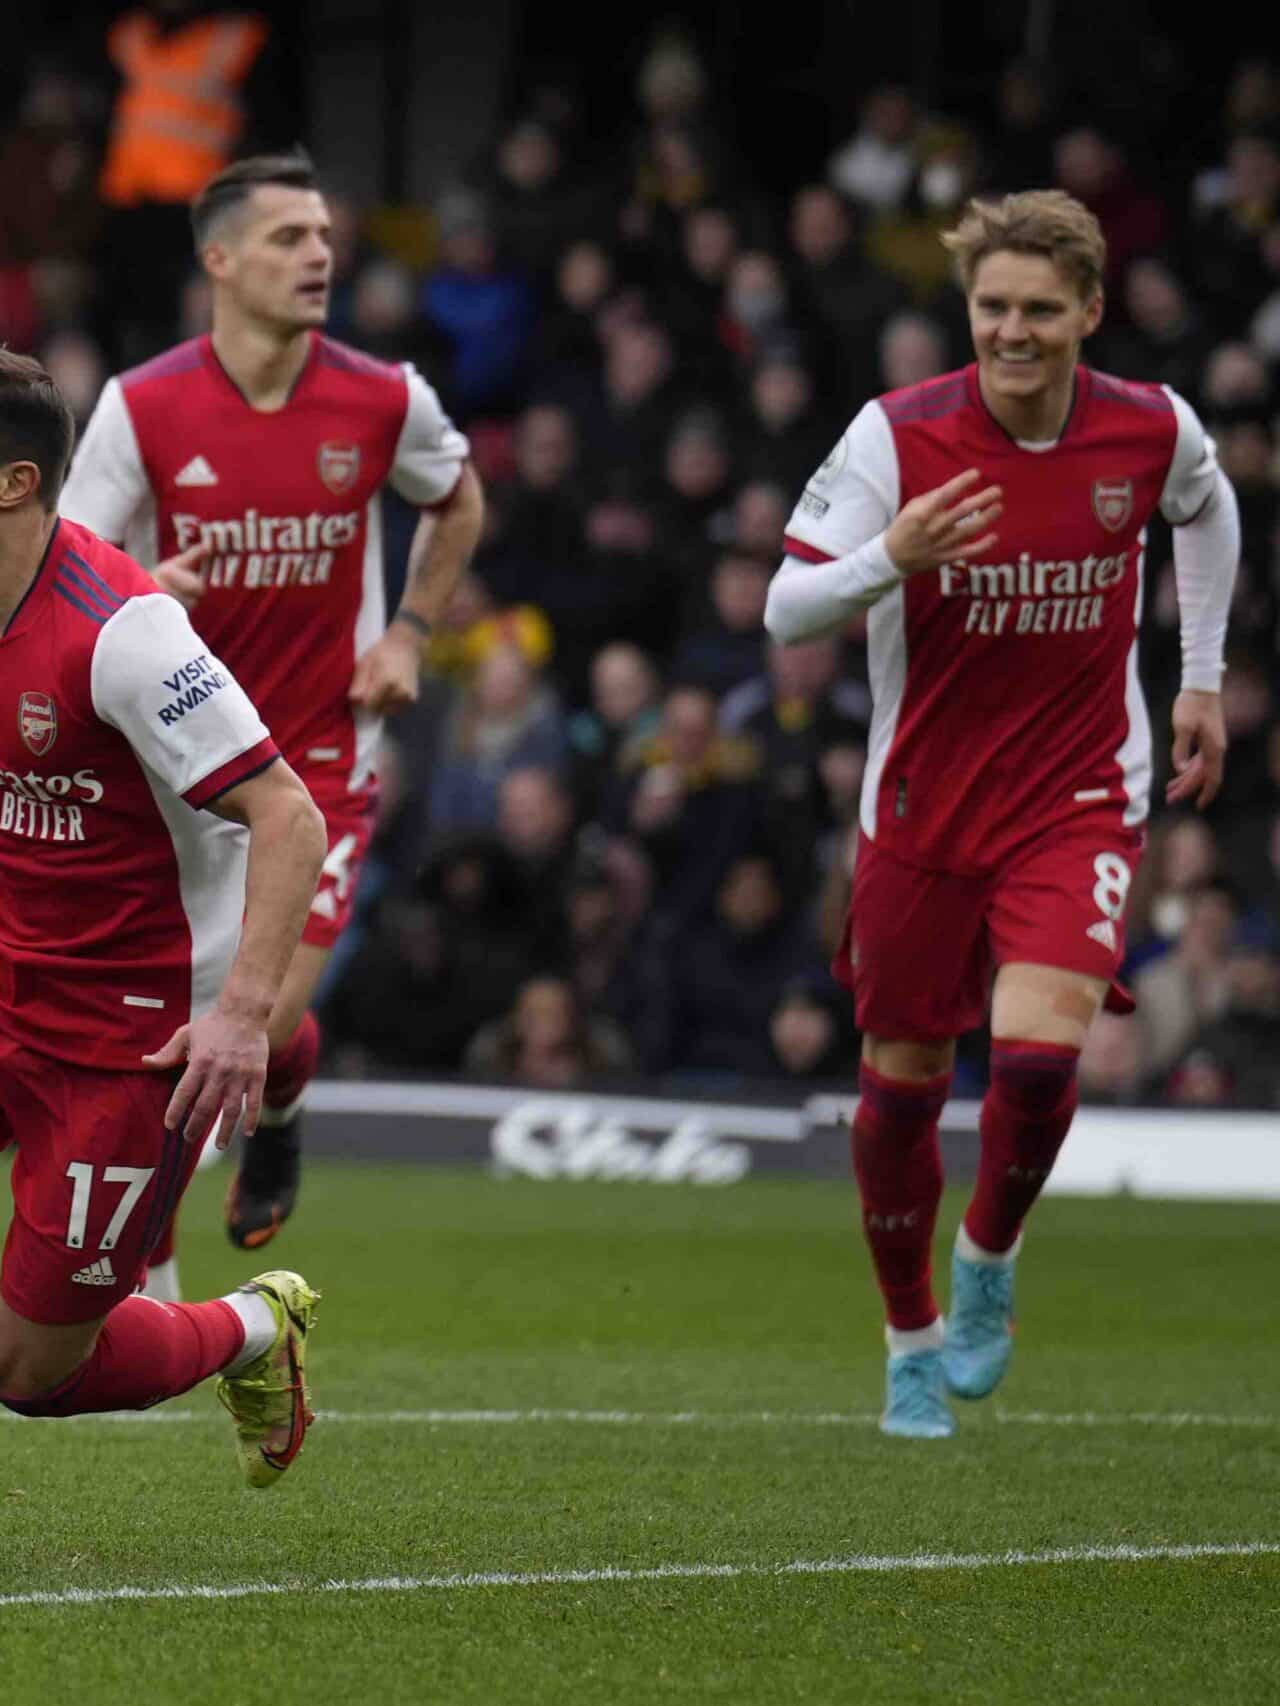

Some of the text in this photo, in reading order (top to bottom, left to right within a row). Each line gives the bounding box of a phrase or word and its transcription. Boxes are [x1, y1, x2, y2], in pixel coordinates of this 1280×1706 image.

[172, 508, 360, 553] Emirates
[243, 551, 334, 590] BETTER
[939, 552, 1129, 597] Emirates
[964, 595, 1104, 636] FLY BETTER
[162, 655, 212, 692] VISIT
[157, 672, 228, 726] RWAND
[0, 791, 86, 841] BETTER
[1092, 851, 1131, 921] 8
[66, 1161, 156, 1250] 17
[71, 1272, 117, 1286] adidas
